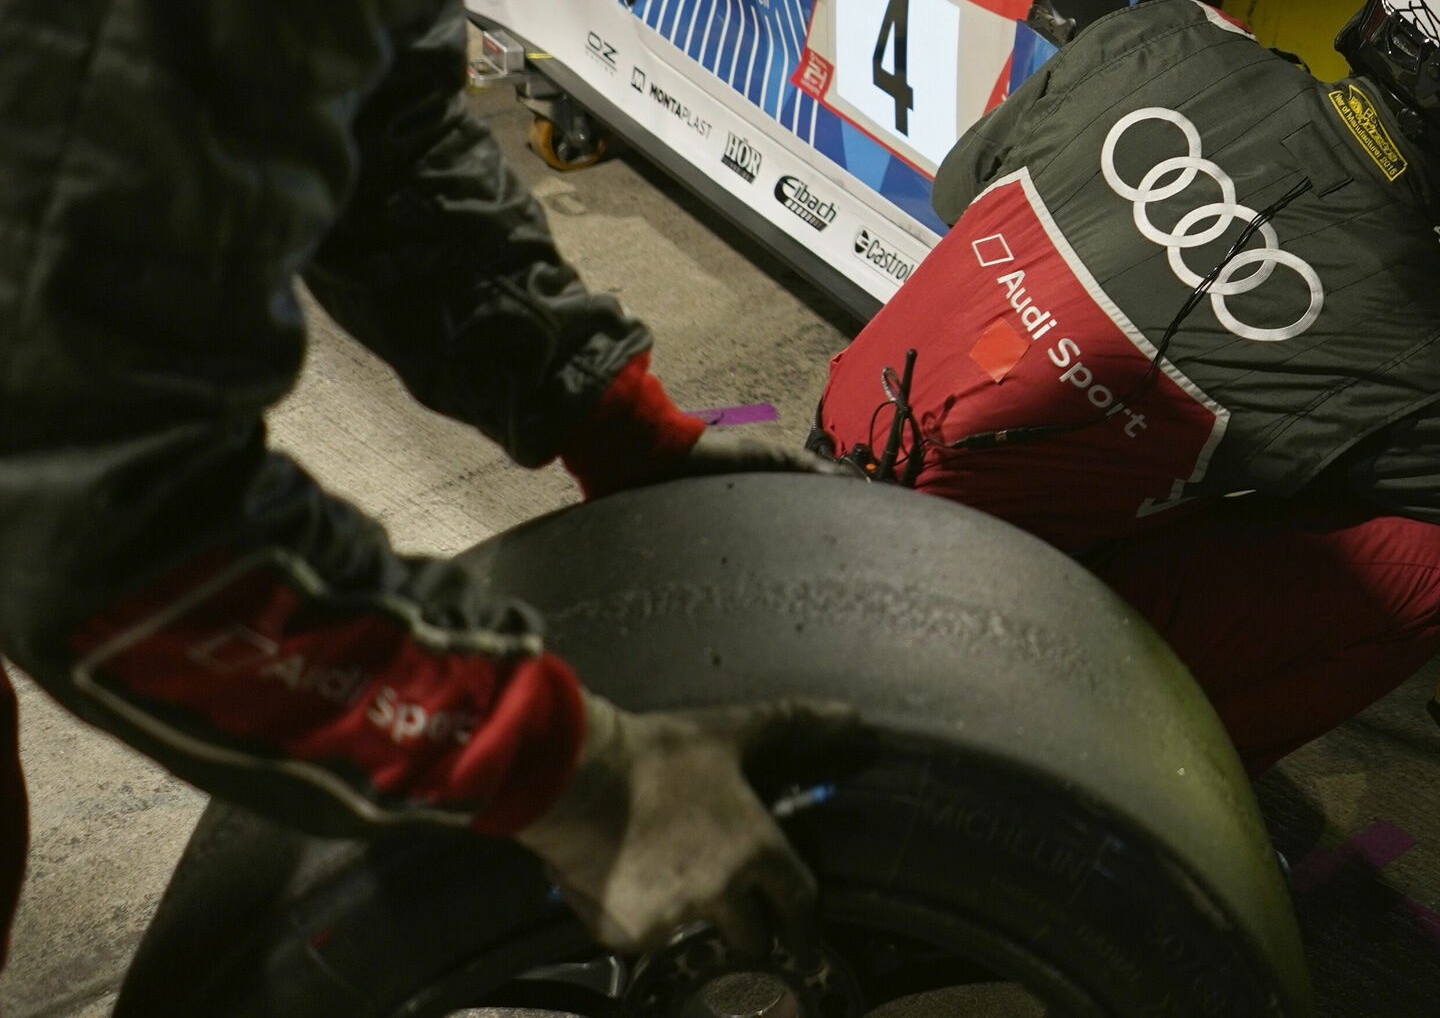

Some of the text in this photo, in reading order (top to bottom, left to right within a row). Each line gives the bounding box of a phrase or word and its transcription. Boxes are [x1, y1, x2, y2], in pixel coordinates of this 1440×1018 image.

[588, 31, 619, 65] OZ
[650, 82, 713, 139] MONTAPLAST
[725, 132, 762, 178] HÖR
[774, 174, 839, 224] Eibach
[866, 239, 915, 283] Castrol
[996, 269, 1148, 439] Audi Sport
